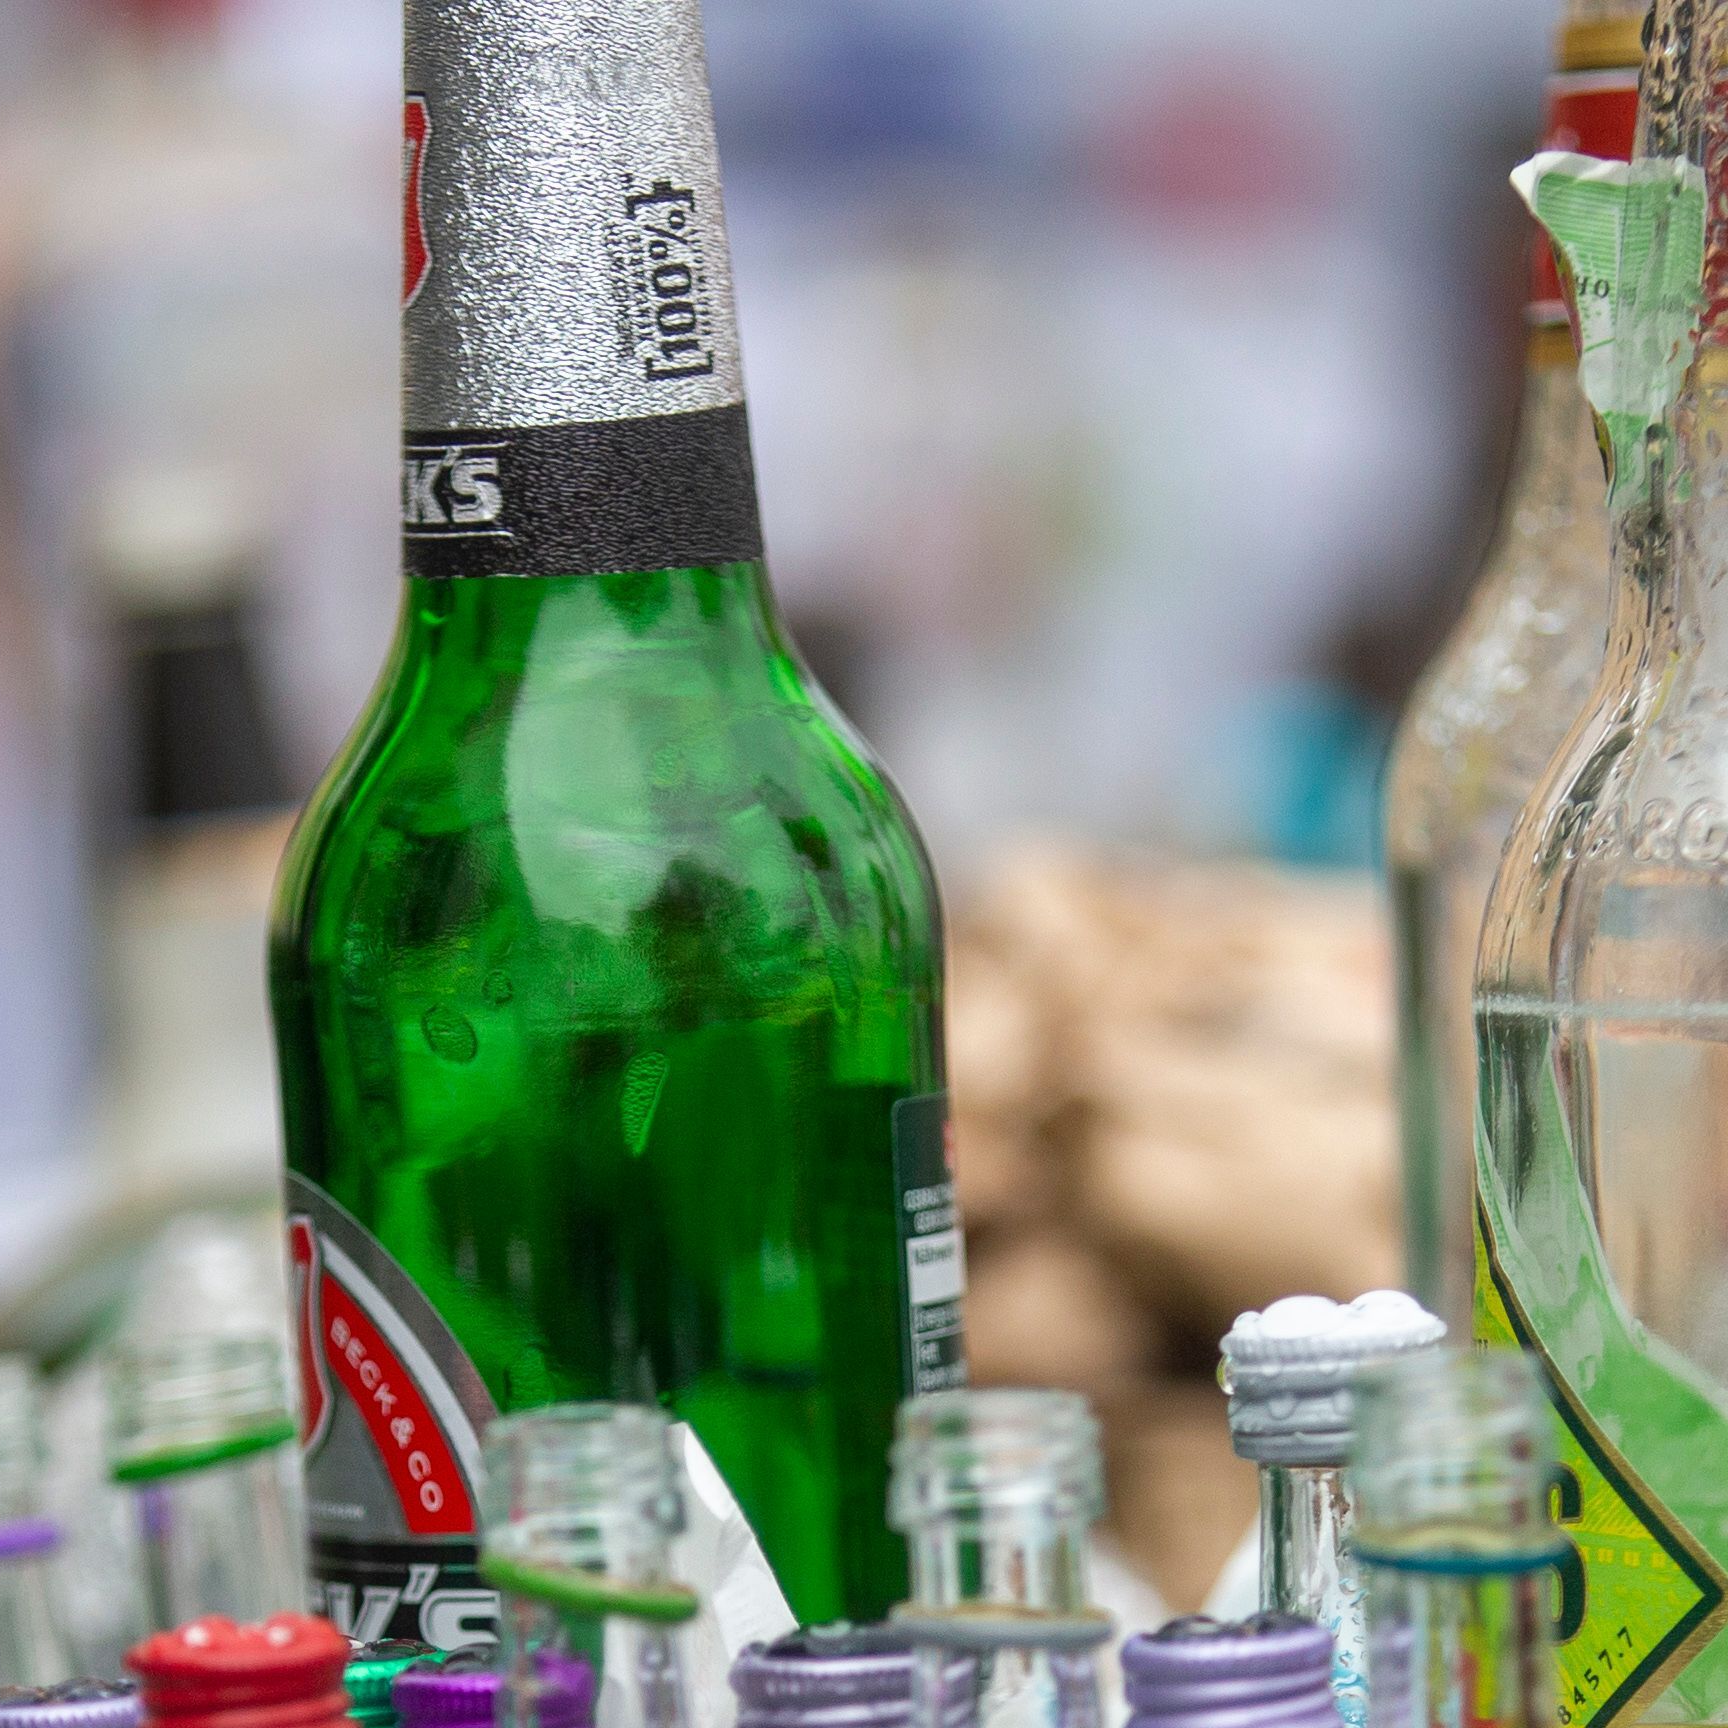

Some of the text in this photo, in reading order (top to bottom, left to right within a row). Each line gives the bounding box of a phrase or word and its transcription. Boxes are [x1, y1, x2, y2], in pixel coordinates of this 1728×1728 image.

[330, 1315, 444, 1514] BECK & CO
